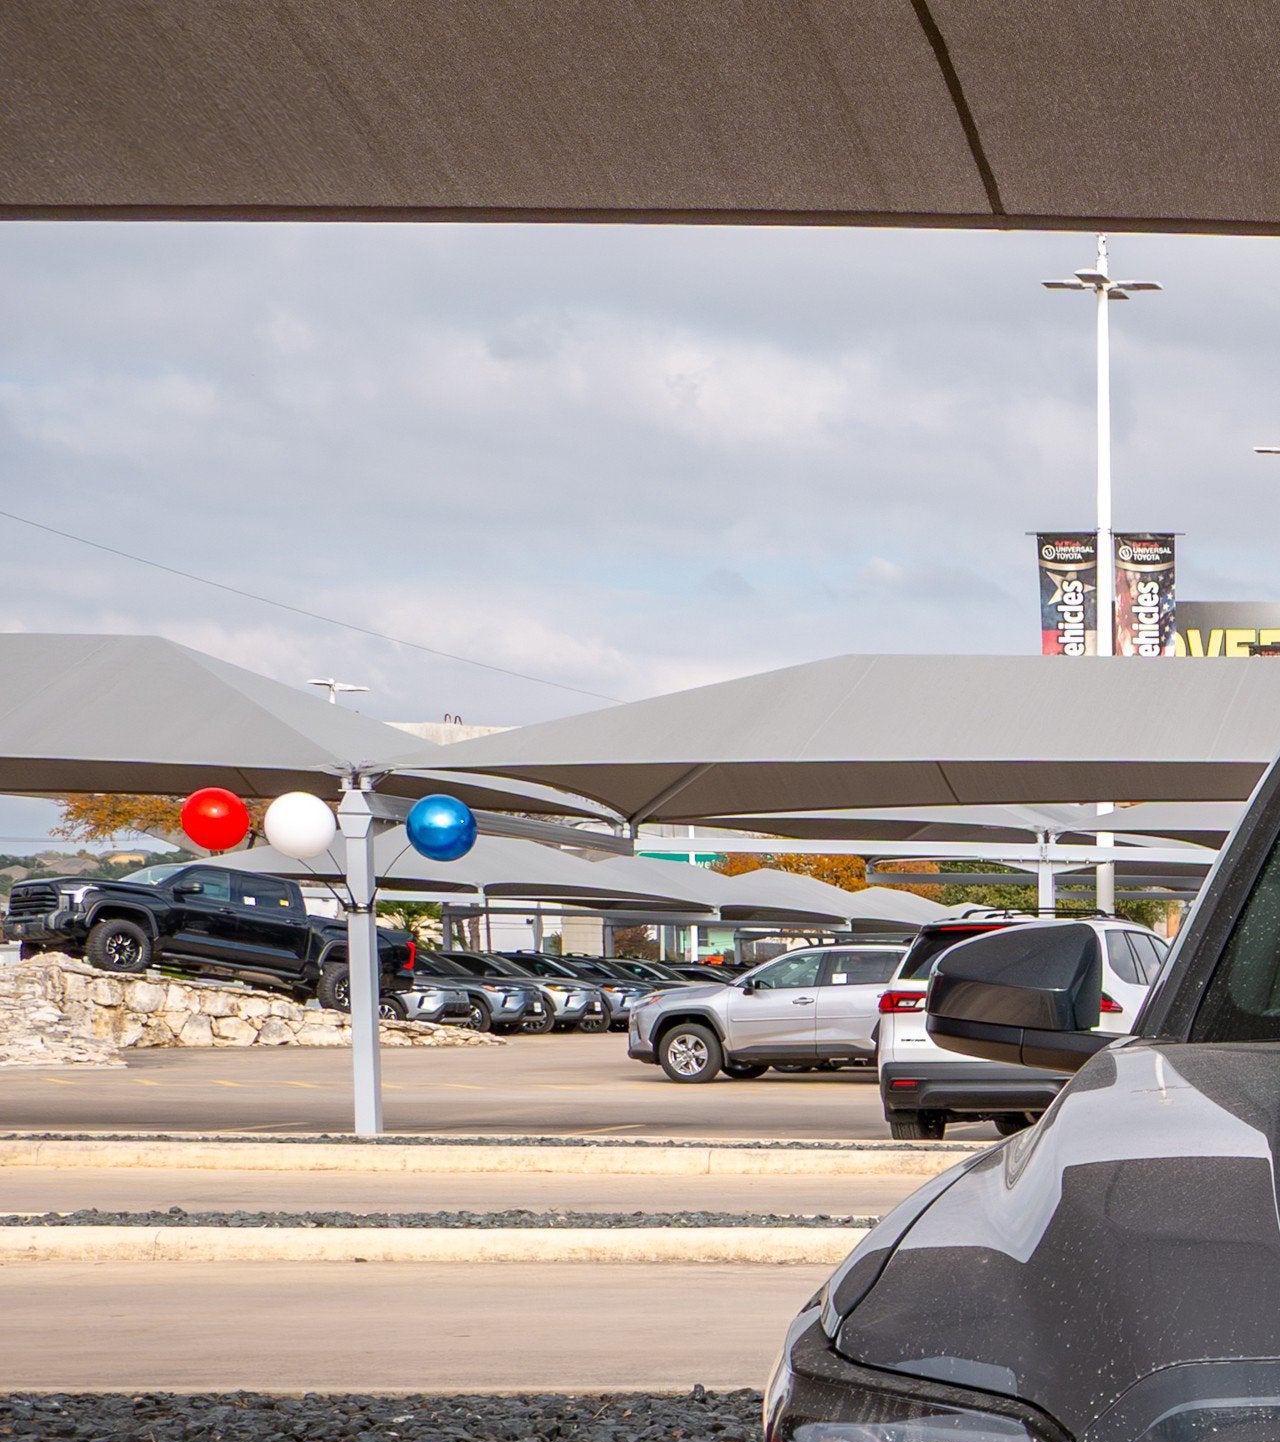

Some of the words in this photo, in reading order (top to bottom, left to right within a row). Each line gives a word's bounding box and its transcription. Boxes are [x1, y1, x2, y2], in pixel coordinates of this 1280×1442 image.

[1055, 546, 1094, 554] UNIVERSAL
[1133, 553, 1160, 561] TOYOTA
[1057, 580, 1085, 656] ehicles
[1131, 581, 1160, 656] ehicles
